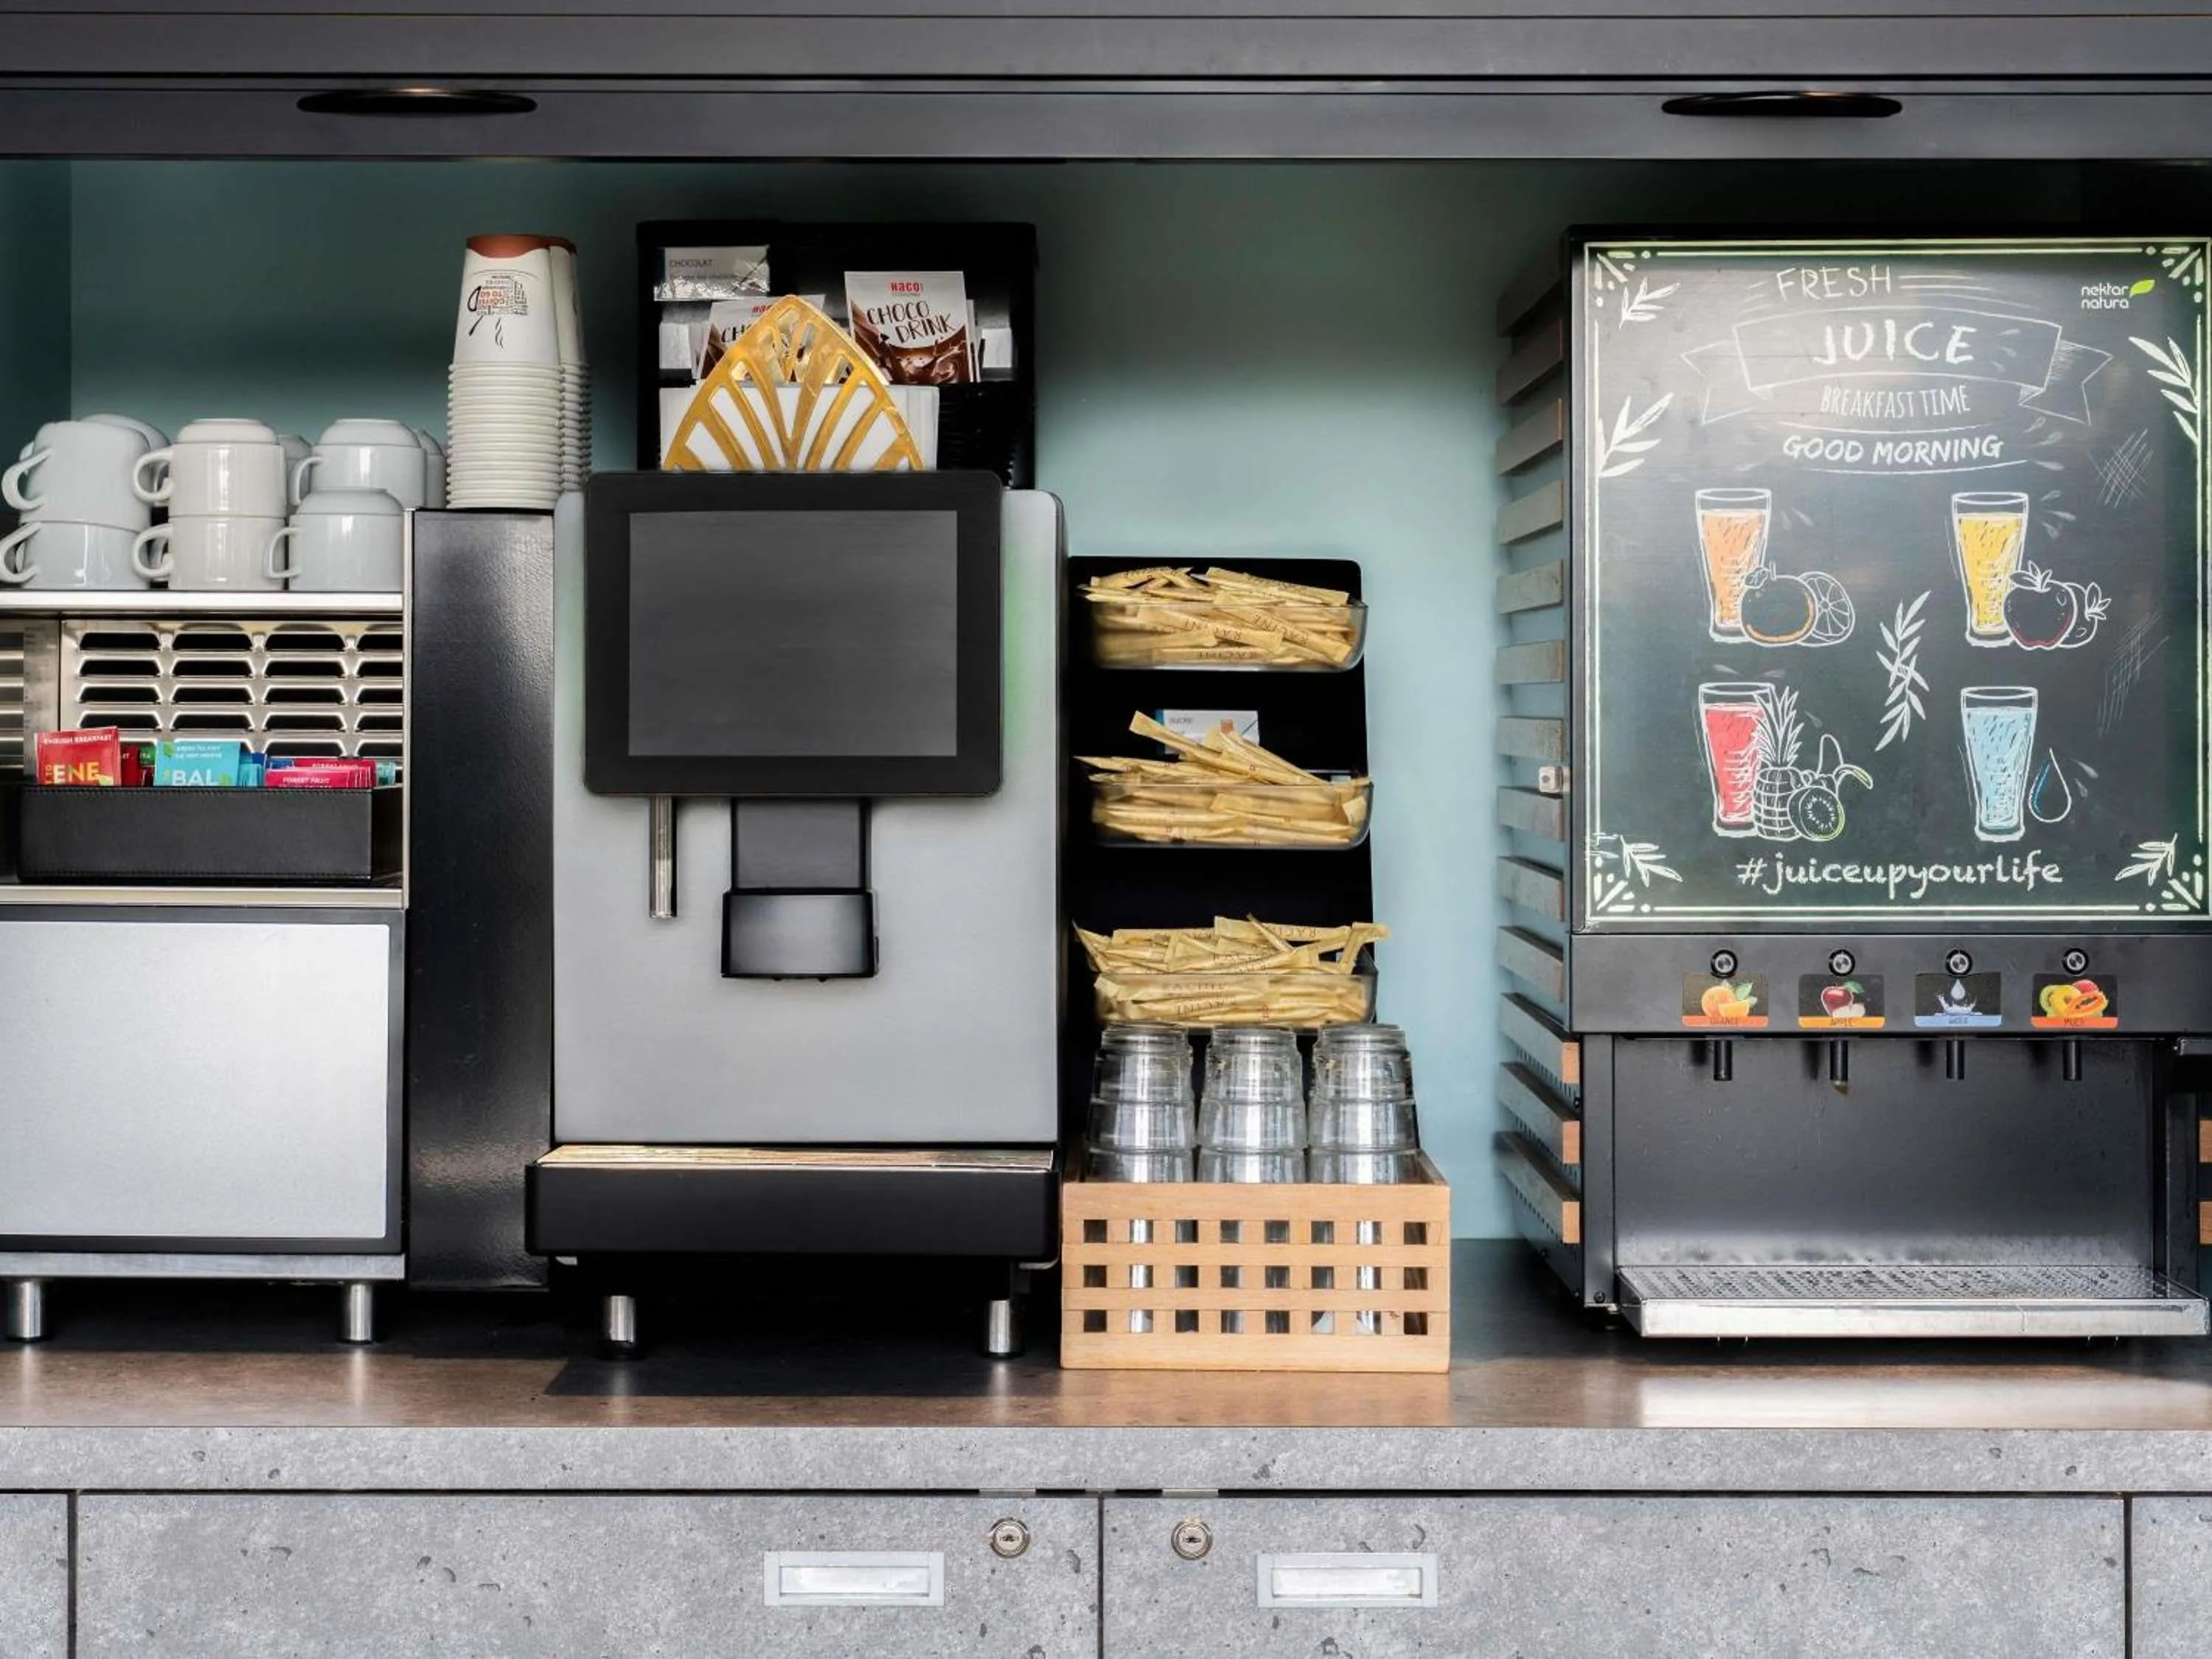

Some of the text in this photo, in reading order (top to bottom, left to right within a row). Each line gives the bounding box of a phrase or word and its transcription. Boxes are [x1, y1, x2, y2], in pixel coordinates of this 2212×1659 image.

[1776, 265, 1891, 301] FRESH
[2081, 283, 2129, 296] nektar
[866, 300, 930, 325] CHOCO
[2081, 296, 2129, 309] natura
[895, 313, 956, 343] DRINK
[1812, 319, 1978, 365] JUICE
[1820, 384, 1971, 420] BREAKFAST TIME
[1782, 434, 2005, 466] GOOD MORNING
[74, 734, 111, 743] BREAKFAST
[1736, 849, 2063, 900] #juiceupyourlife
